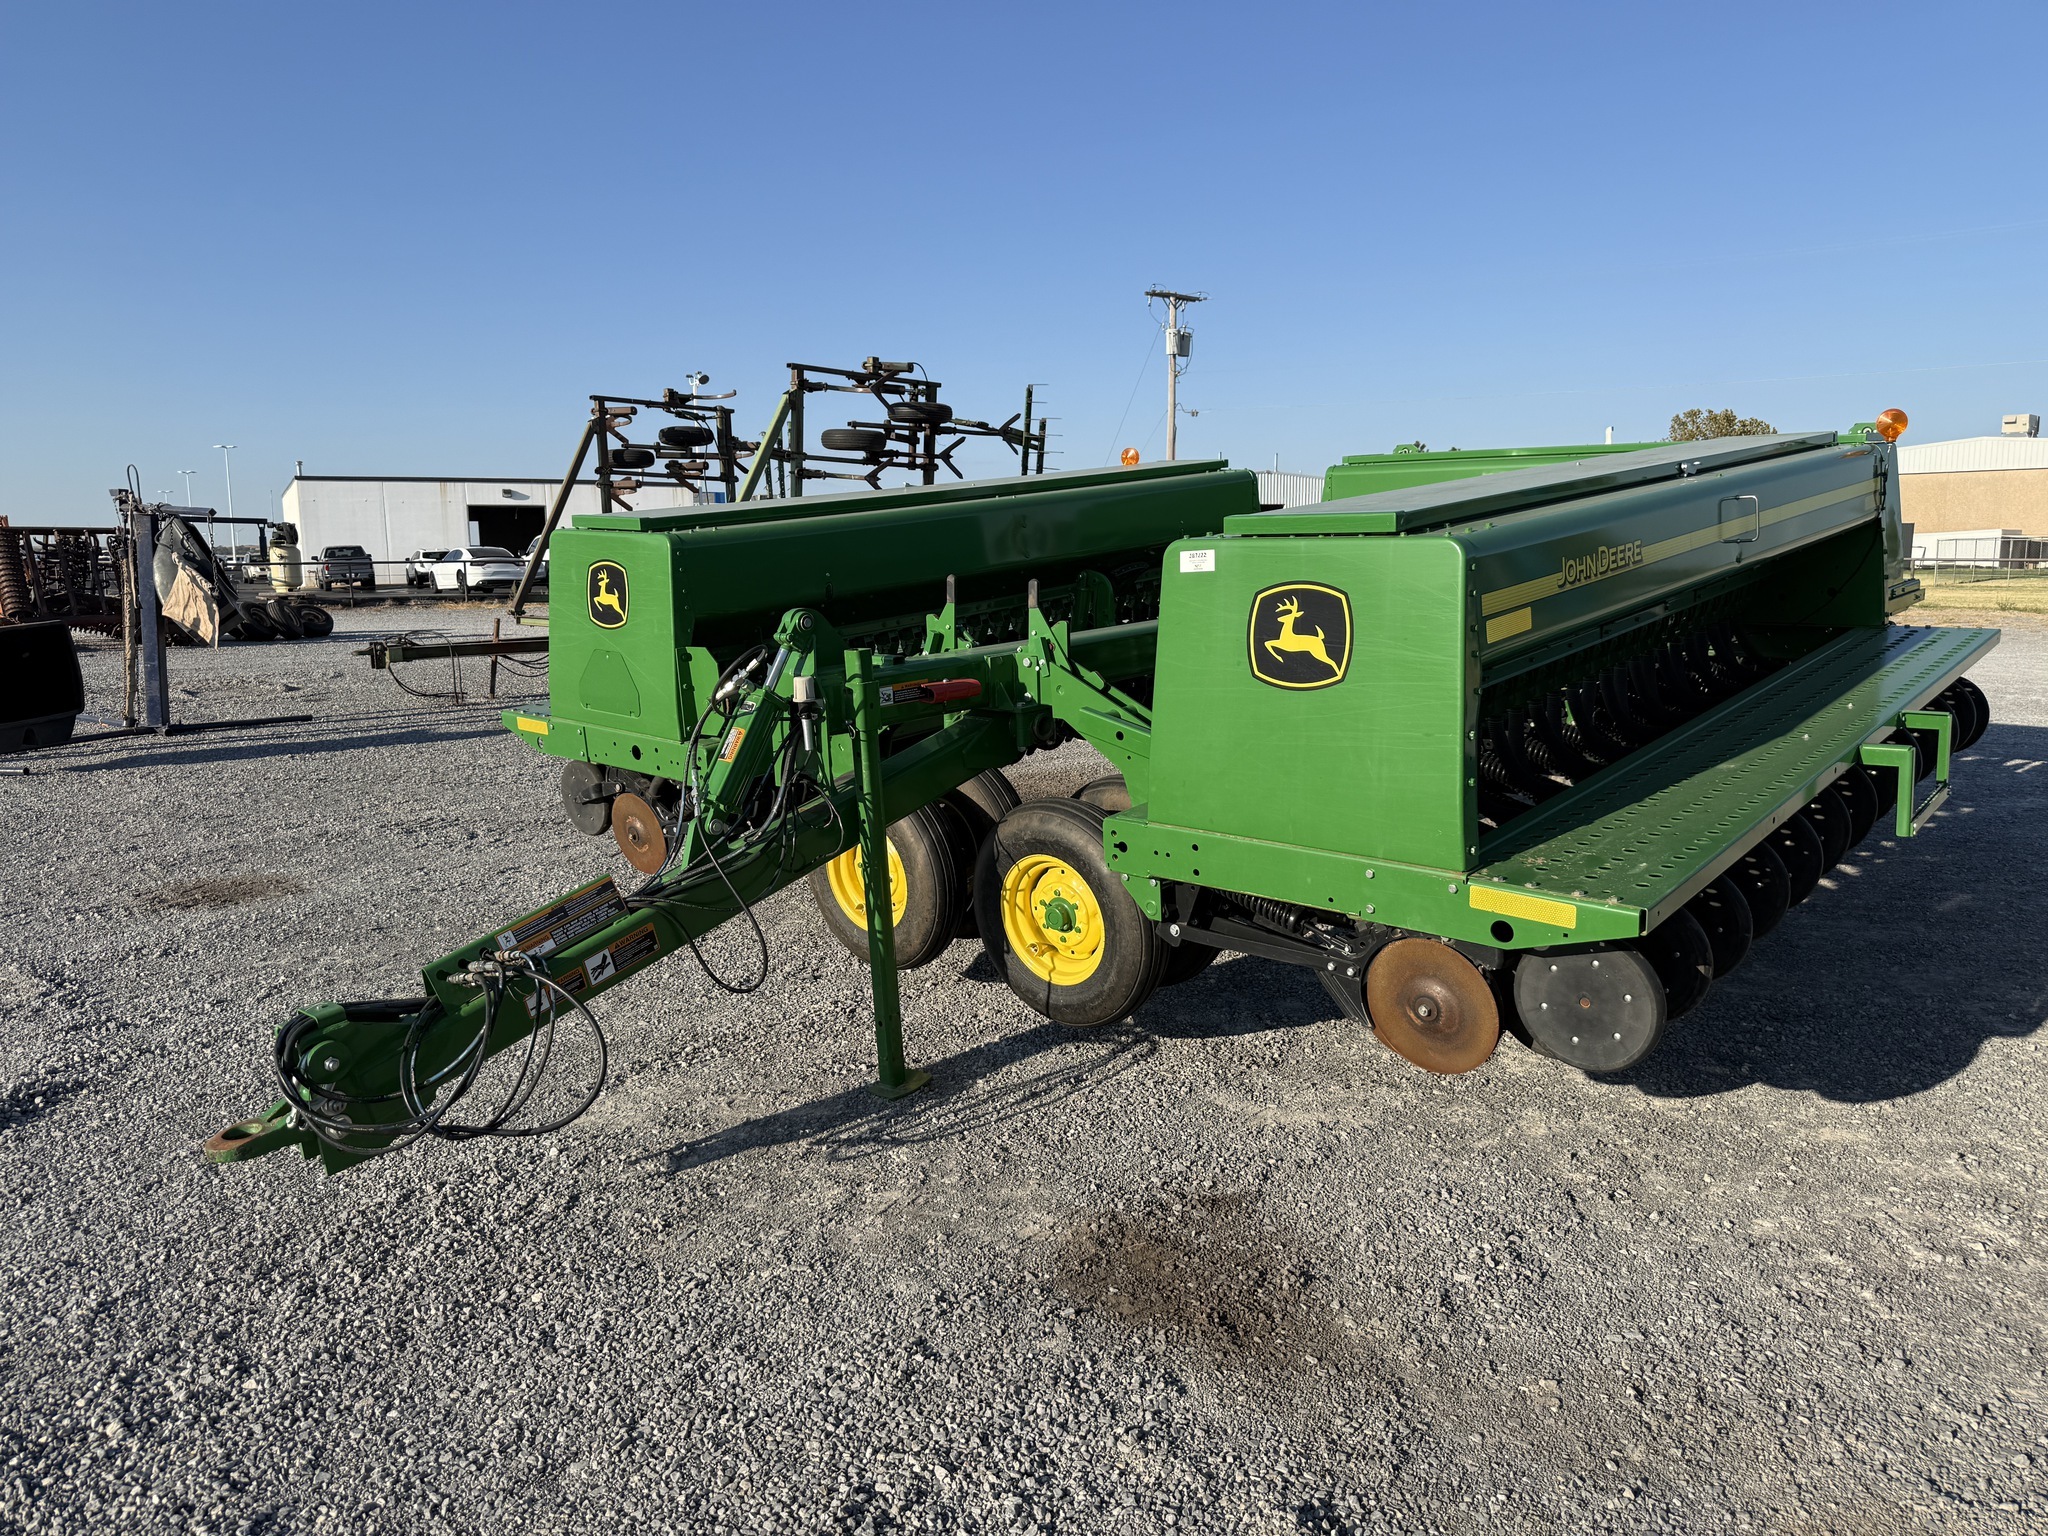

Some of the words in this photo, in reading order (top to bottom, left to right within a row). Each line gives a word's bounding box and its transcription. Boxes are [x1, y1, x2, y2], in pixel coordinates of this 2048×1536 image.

[1557, 553, 1598, 587] JOHN
[1598, 540, 1642, 573] DEERE
[619, 926, 649, 945] WARNING
